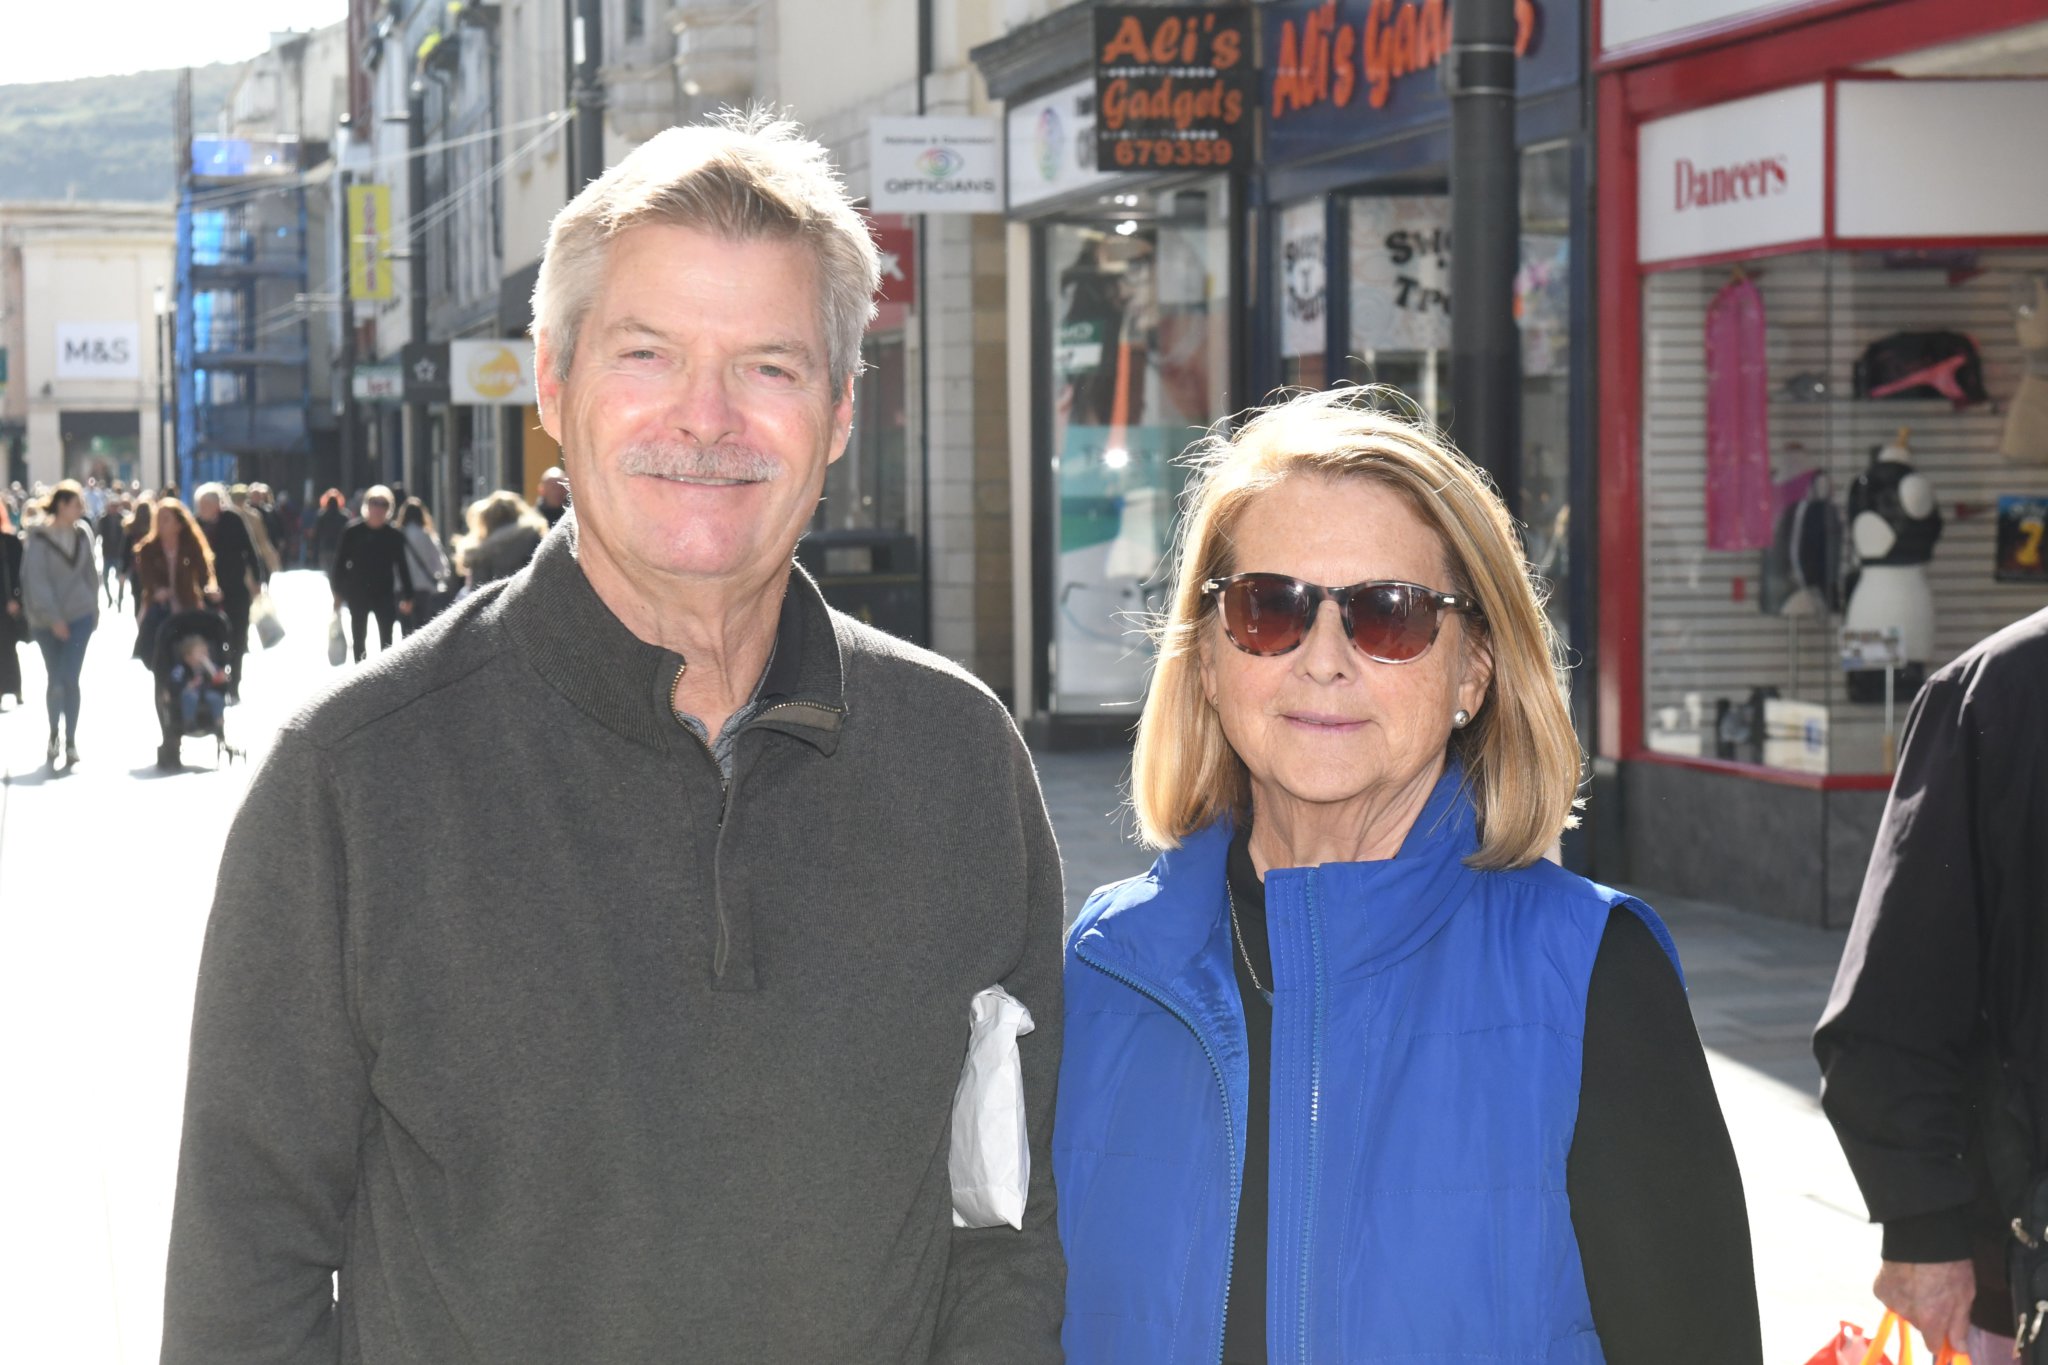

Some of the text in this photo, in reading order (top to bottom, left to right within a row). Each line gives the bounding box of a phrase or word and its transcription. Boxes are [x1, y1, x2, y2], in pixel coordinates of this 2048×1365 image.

[1102, 12, 1241, 69] Ali's
[1103, 77, 1242, 129] Gadgets
[1115, 139, 1232, 165] 679359
[884, 179, 995, 194] OPTICIANS
[1674, 154, 1787, 212] Dancers
[64, 337, 130, 365] M&S
